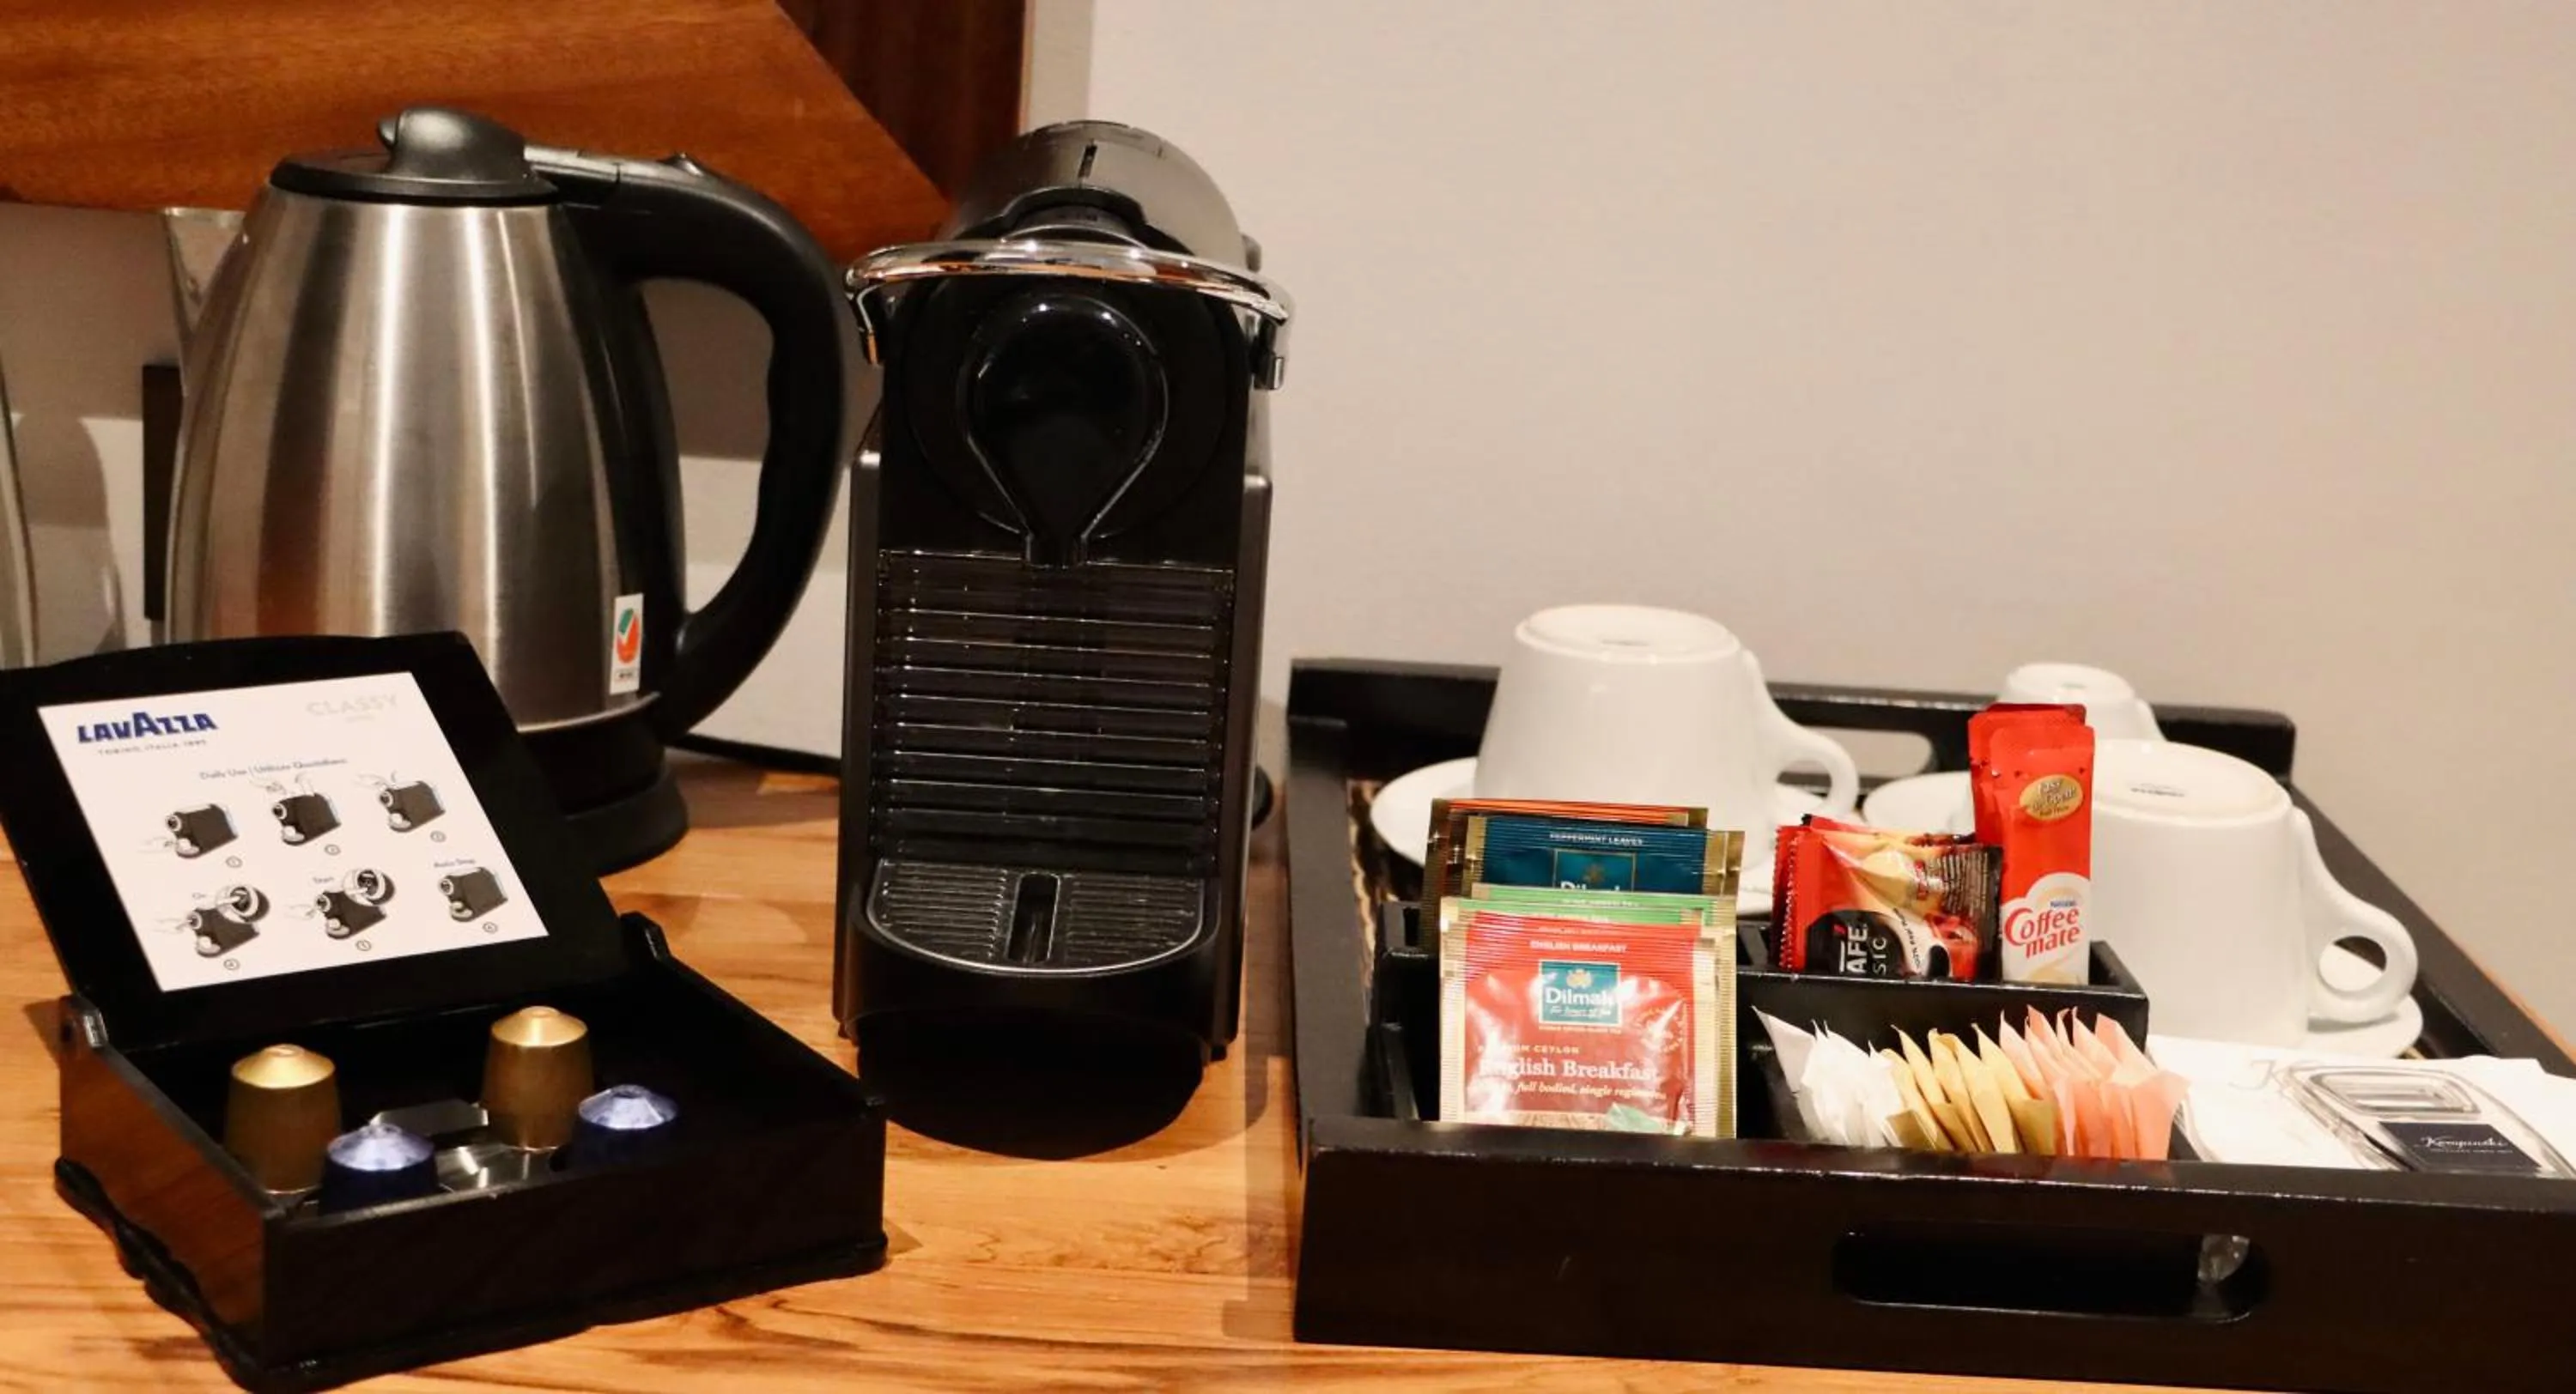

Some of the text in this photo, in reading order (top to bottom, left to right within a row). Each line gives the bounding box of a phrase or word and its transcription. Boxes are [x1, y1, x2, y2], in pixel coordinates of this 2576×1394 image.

[76, 711, 219, 744] LAVAZZA
[2004, 907, 2080, 948] Coffee
[2026, 926, 2080, 959] mate
[1872, 936, 1888, 976] SIC
[1545, 986, 1616, 1005] Dilmah
[1563, 1059, 1661, 1082] Breakfast
